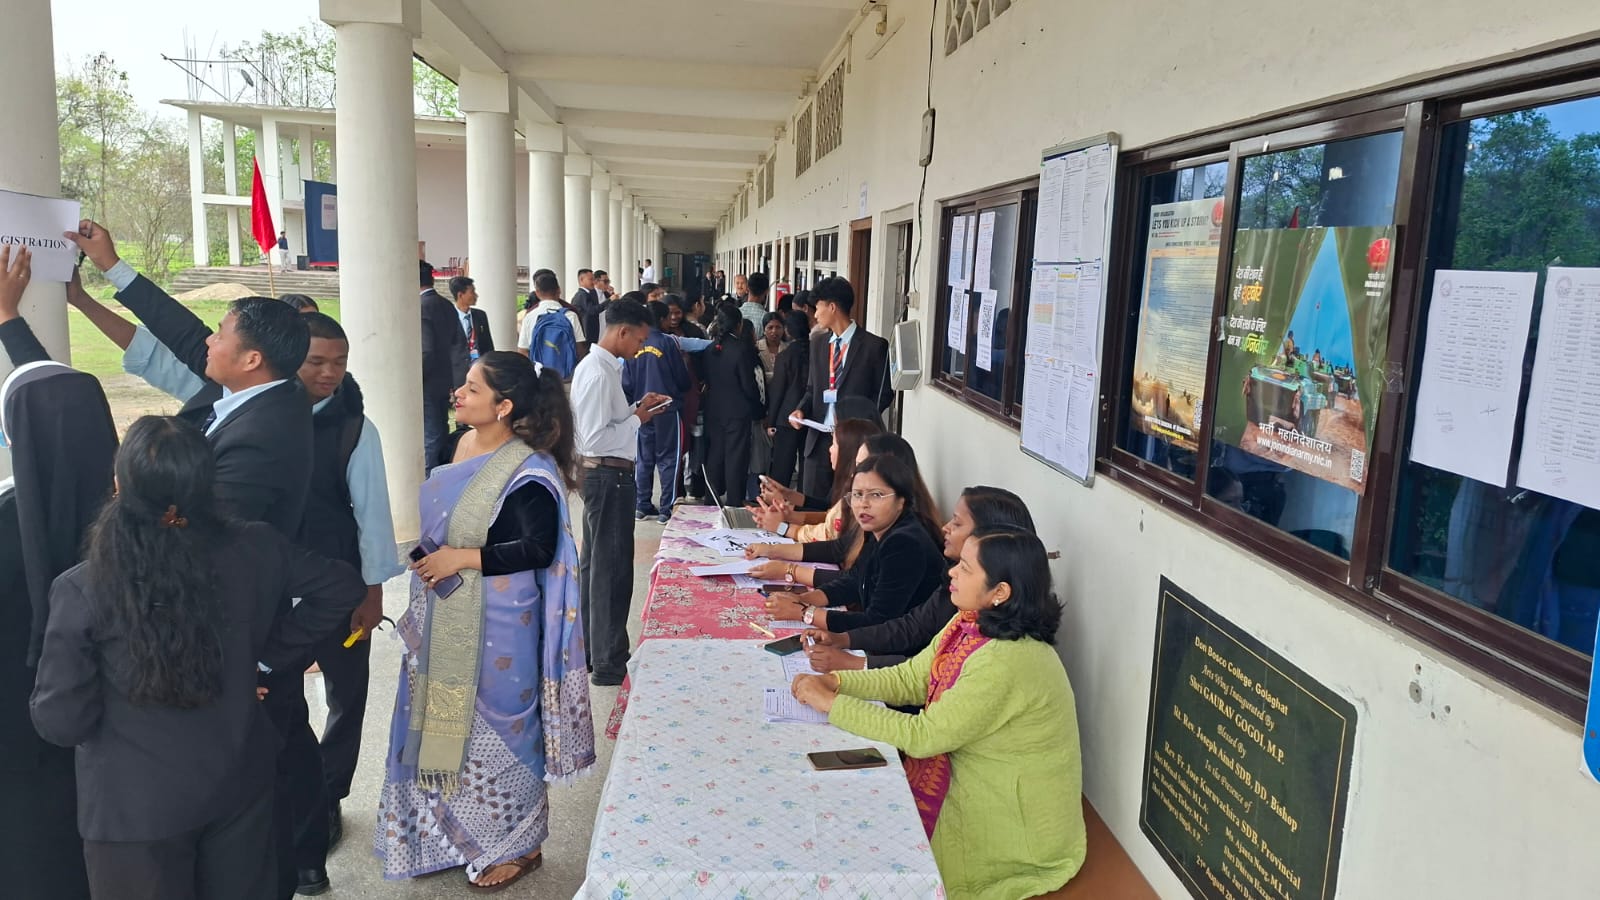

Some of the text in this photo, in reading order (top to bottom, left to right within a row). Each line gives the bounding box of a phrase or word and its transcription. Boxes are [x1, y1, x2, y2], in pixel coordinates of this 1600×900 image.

[1258, 421, 1333, 455] भर्ती महानिदेशालय
[1195, 636, 1288, 715] Don Bosco College, Golaghat
[1190, 675, 1202, 694] Shri
[1204, 687, 1234, 719] GAURAV
[1235, 714, 1265, 750] GOGOI,
[1197, 727, 1217, 754] Joseph
[1271, 796, 1297, 832] Bishop
[1212, 768, 1220, 780] the
[1244, 801, 1252, 813] of
[1261, 840, 1300, 890] Provincial
